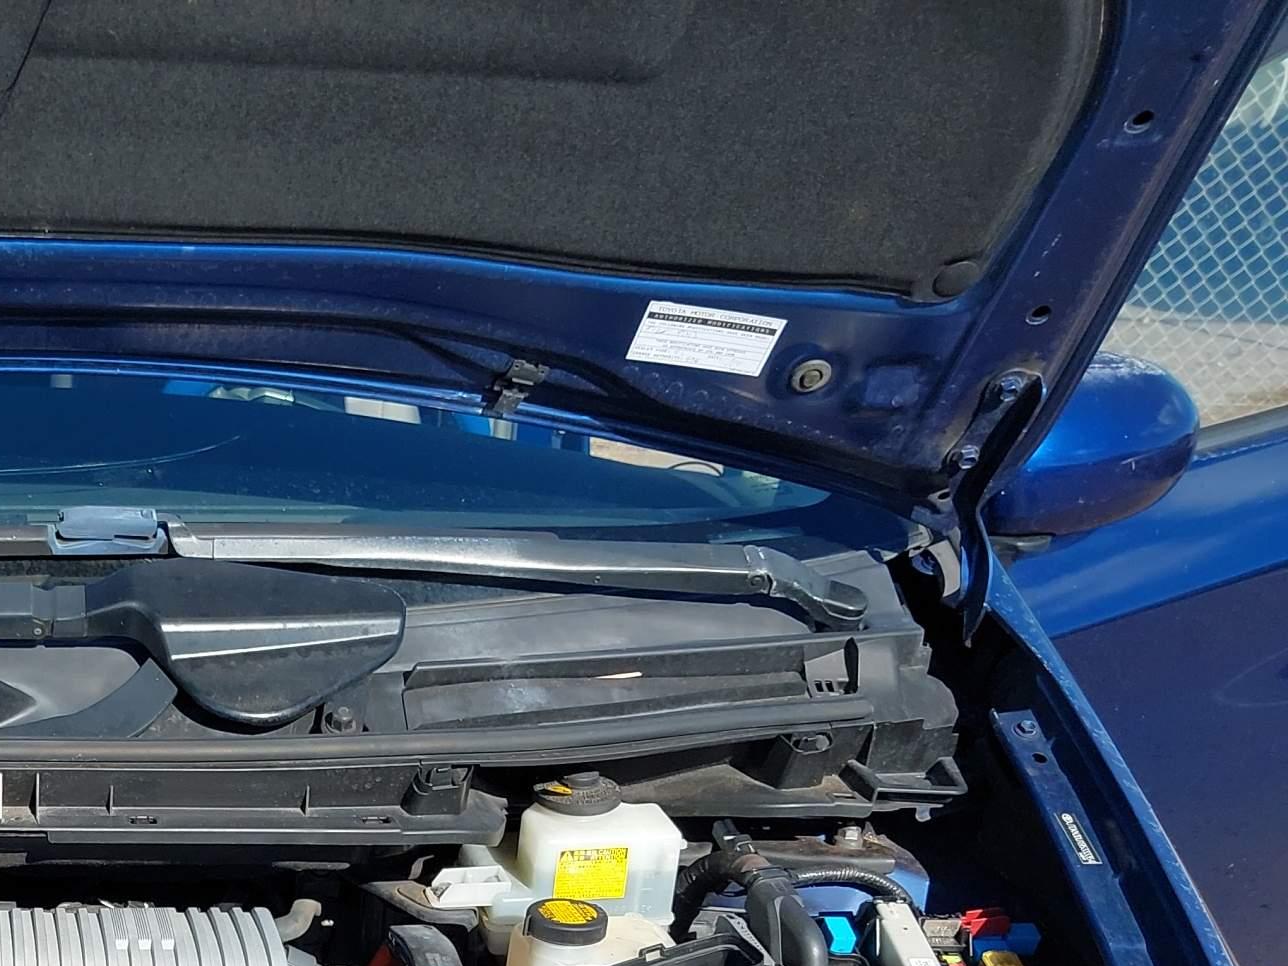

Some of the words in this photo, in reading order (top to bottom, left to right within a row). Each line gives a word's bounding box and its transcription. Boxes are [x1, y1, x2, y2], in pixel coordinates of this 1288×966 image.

[653, 313, 703, 324] AUTHORIZED
[707, 320, 770, 334] MODIFICATIONS
[689, 310, 716, 318] MOTOR
[720, 313, 773, 326] CORPORATION
